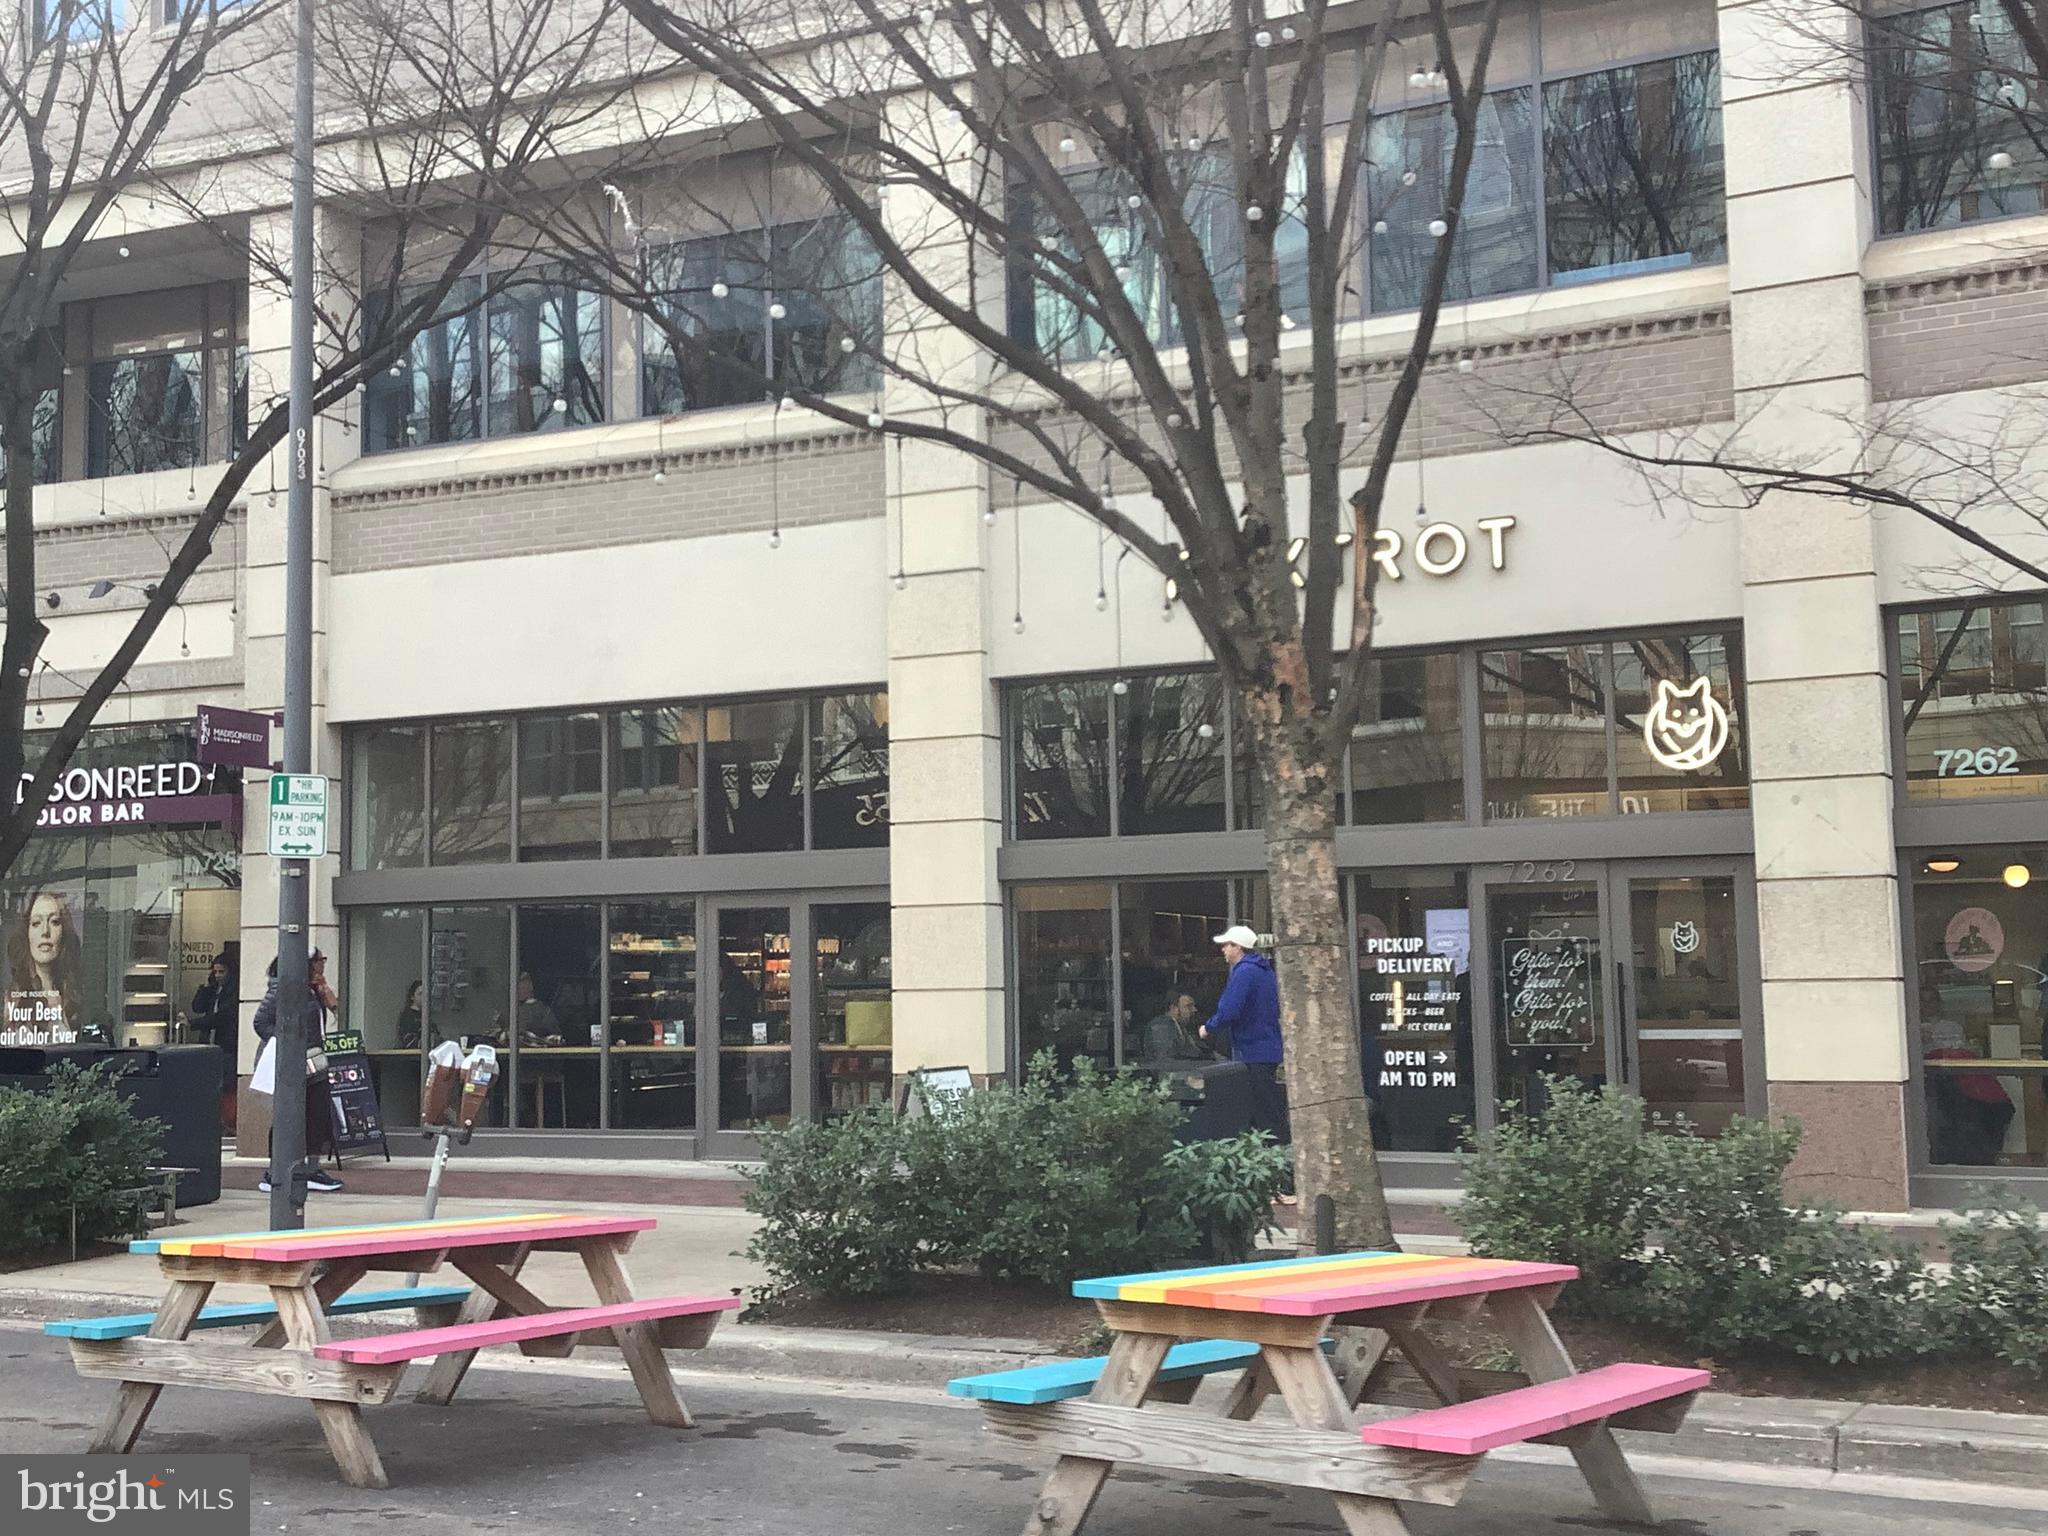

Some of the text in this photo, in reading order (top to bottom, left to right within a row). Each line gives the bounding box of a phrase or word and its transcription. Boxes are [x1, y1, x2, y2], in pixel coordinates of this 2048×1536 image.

[1934, 746, 2020, 777] 7262
[278, 780, 284, 801] 1
[291, 793, 322, 804] PARKING
[36, 803, 144, 826] OLOR BAR
[279, 827, 316, 837] EX SUN
[1503, 860, 1576, 883] 7262
[1368, 937, 1424, 953] PICKUP
[1378, 957, 1453, 974] DELIVERY
[1510, 948, 1585, 976] Gifts for
[1524, 968, 1574, 989] them!
[1370, 992, 1462, 1001] COFFE ALL DAY EATS
[1512, 989, 1587, 1017] Gifts for
[8, 1001, 63, 1021] Your Best
[1386, 1007, 1445, 1016] SCKS BEER
[1407, 1022, 1420, 1031] ICE
[1423, 1022, 1452, 1031] CREAM
[1527, 1009, 1573, 1037] you!
[0, 1025, 78, 1045] air Color Ever
[339, 1036, 359, 1049] OFF
[1384, 1051, 1426, 1066] OPEN
[1380, 1071, 1456, 1087] AM TO PM
